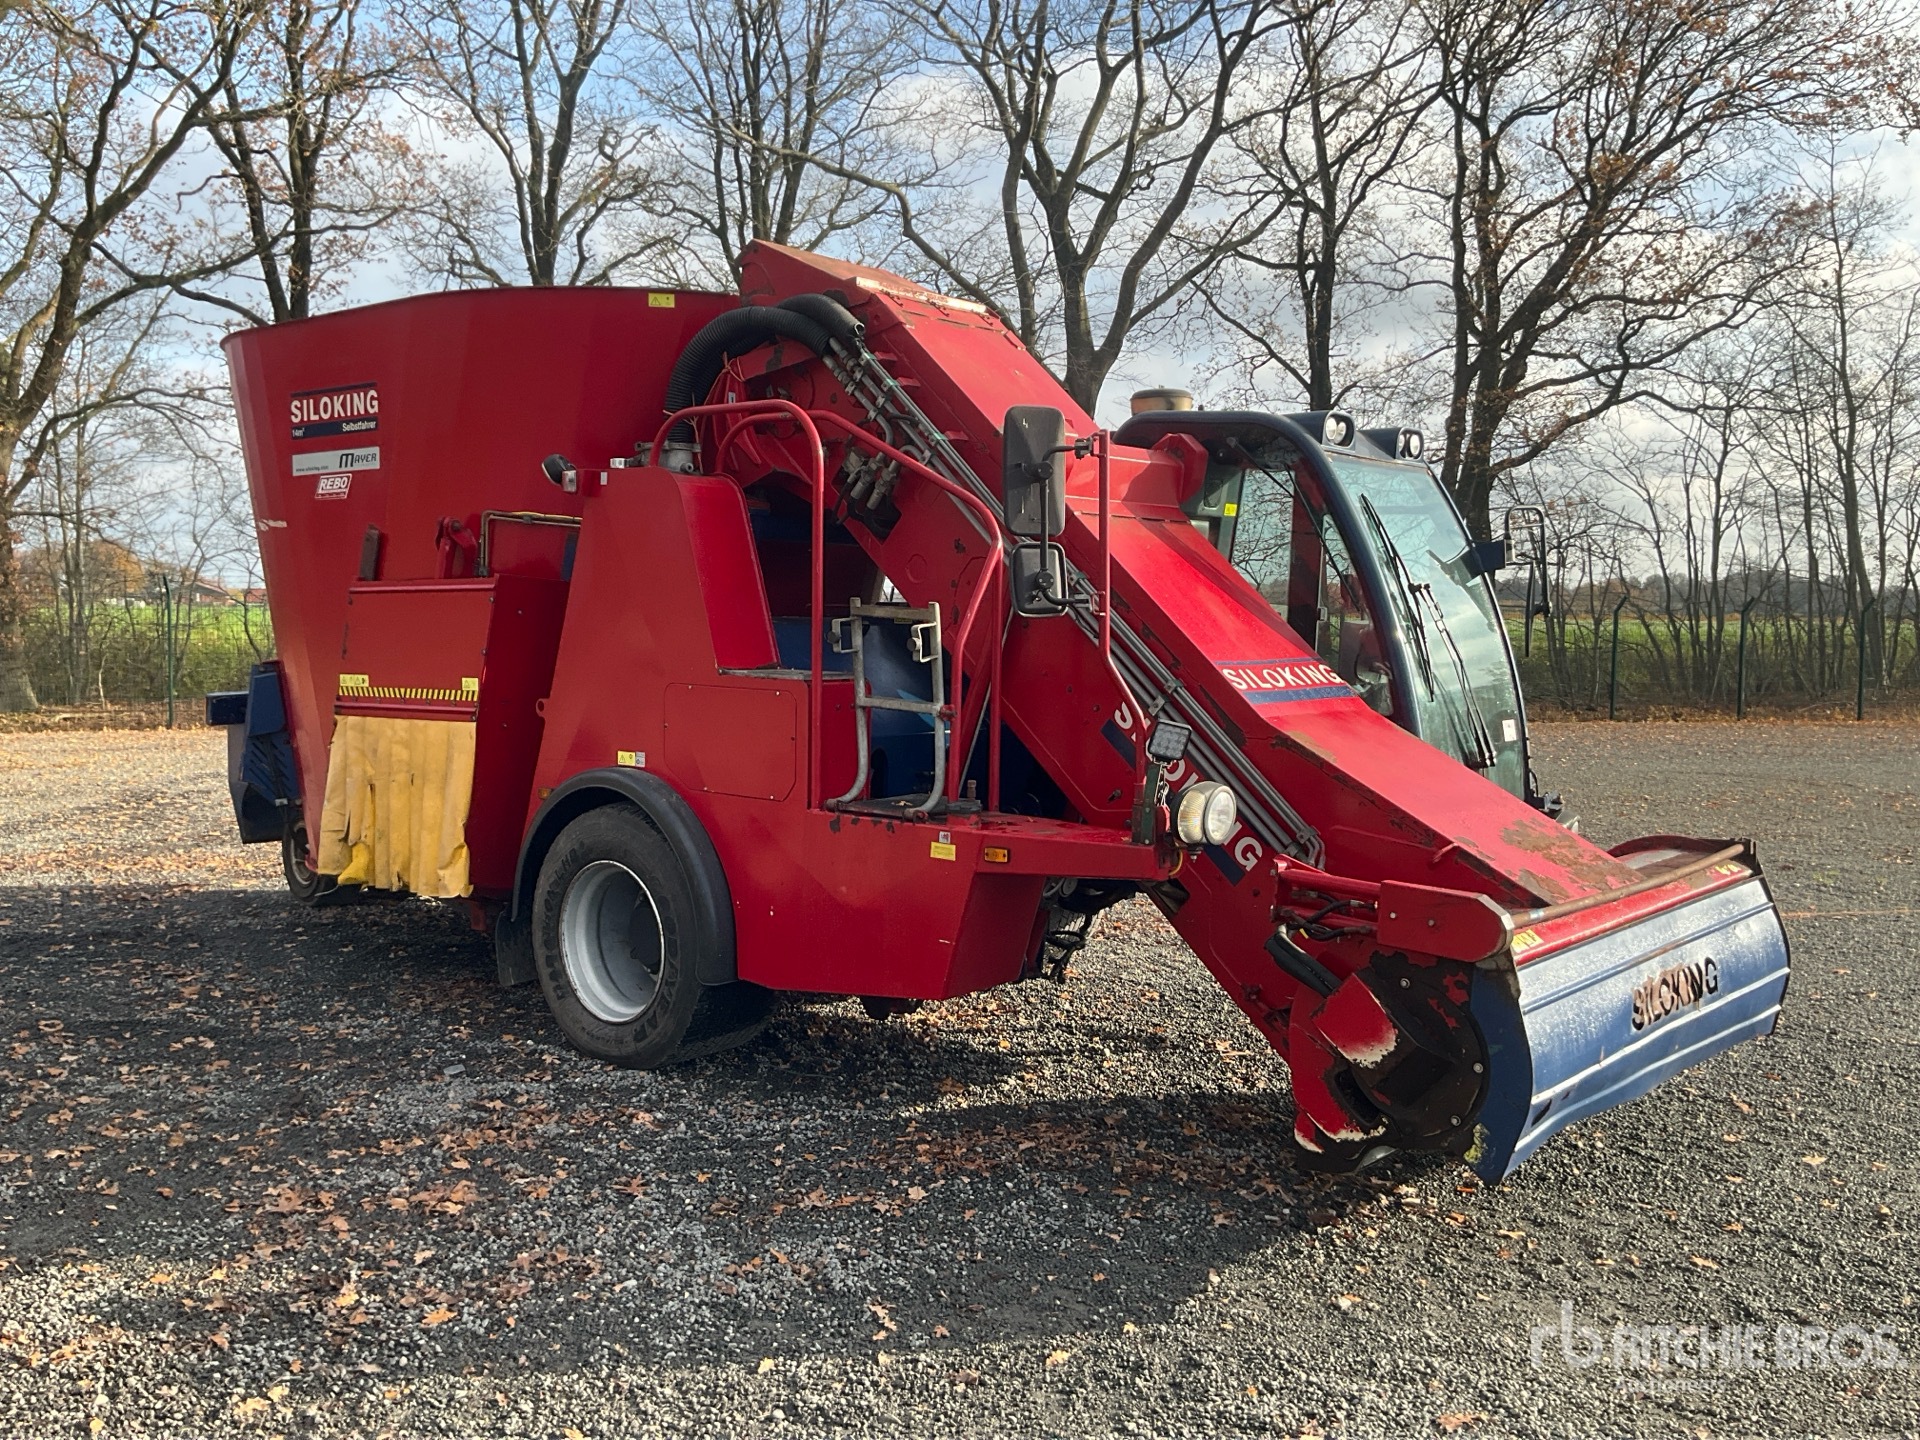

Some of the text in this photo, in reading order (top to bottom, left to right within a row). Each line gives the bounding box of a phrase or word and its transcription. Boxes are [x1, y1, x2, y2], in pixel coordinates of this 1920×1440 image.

[291, 390, 379, 423] SILOKING
[342, 420, 377, 432] Selbstfahrer
[339, 453, 377, 469] MAYER
[320, 477, 348, 490] REBO
[1222, 664, 1342, 690] SILOKING
[1632, 957, 1718, 1031] SILOKING
